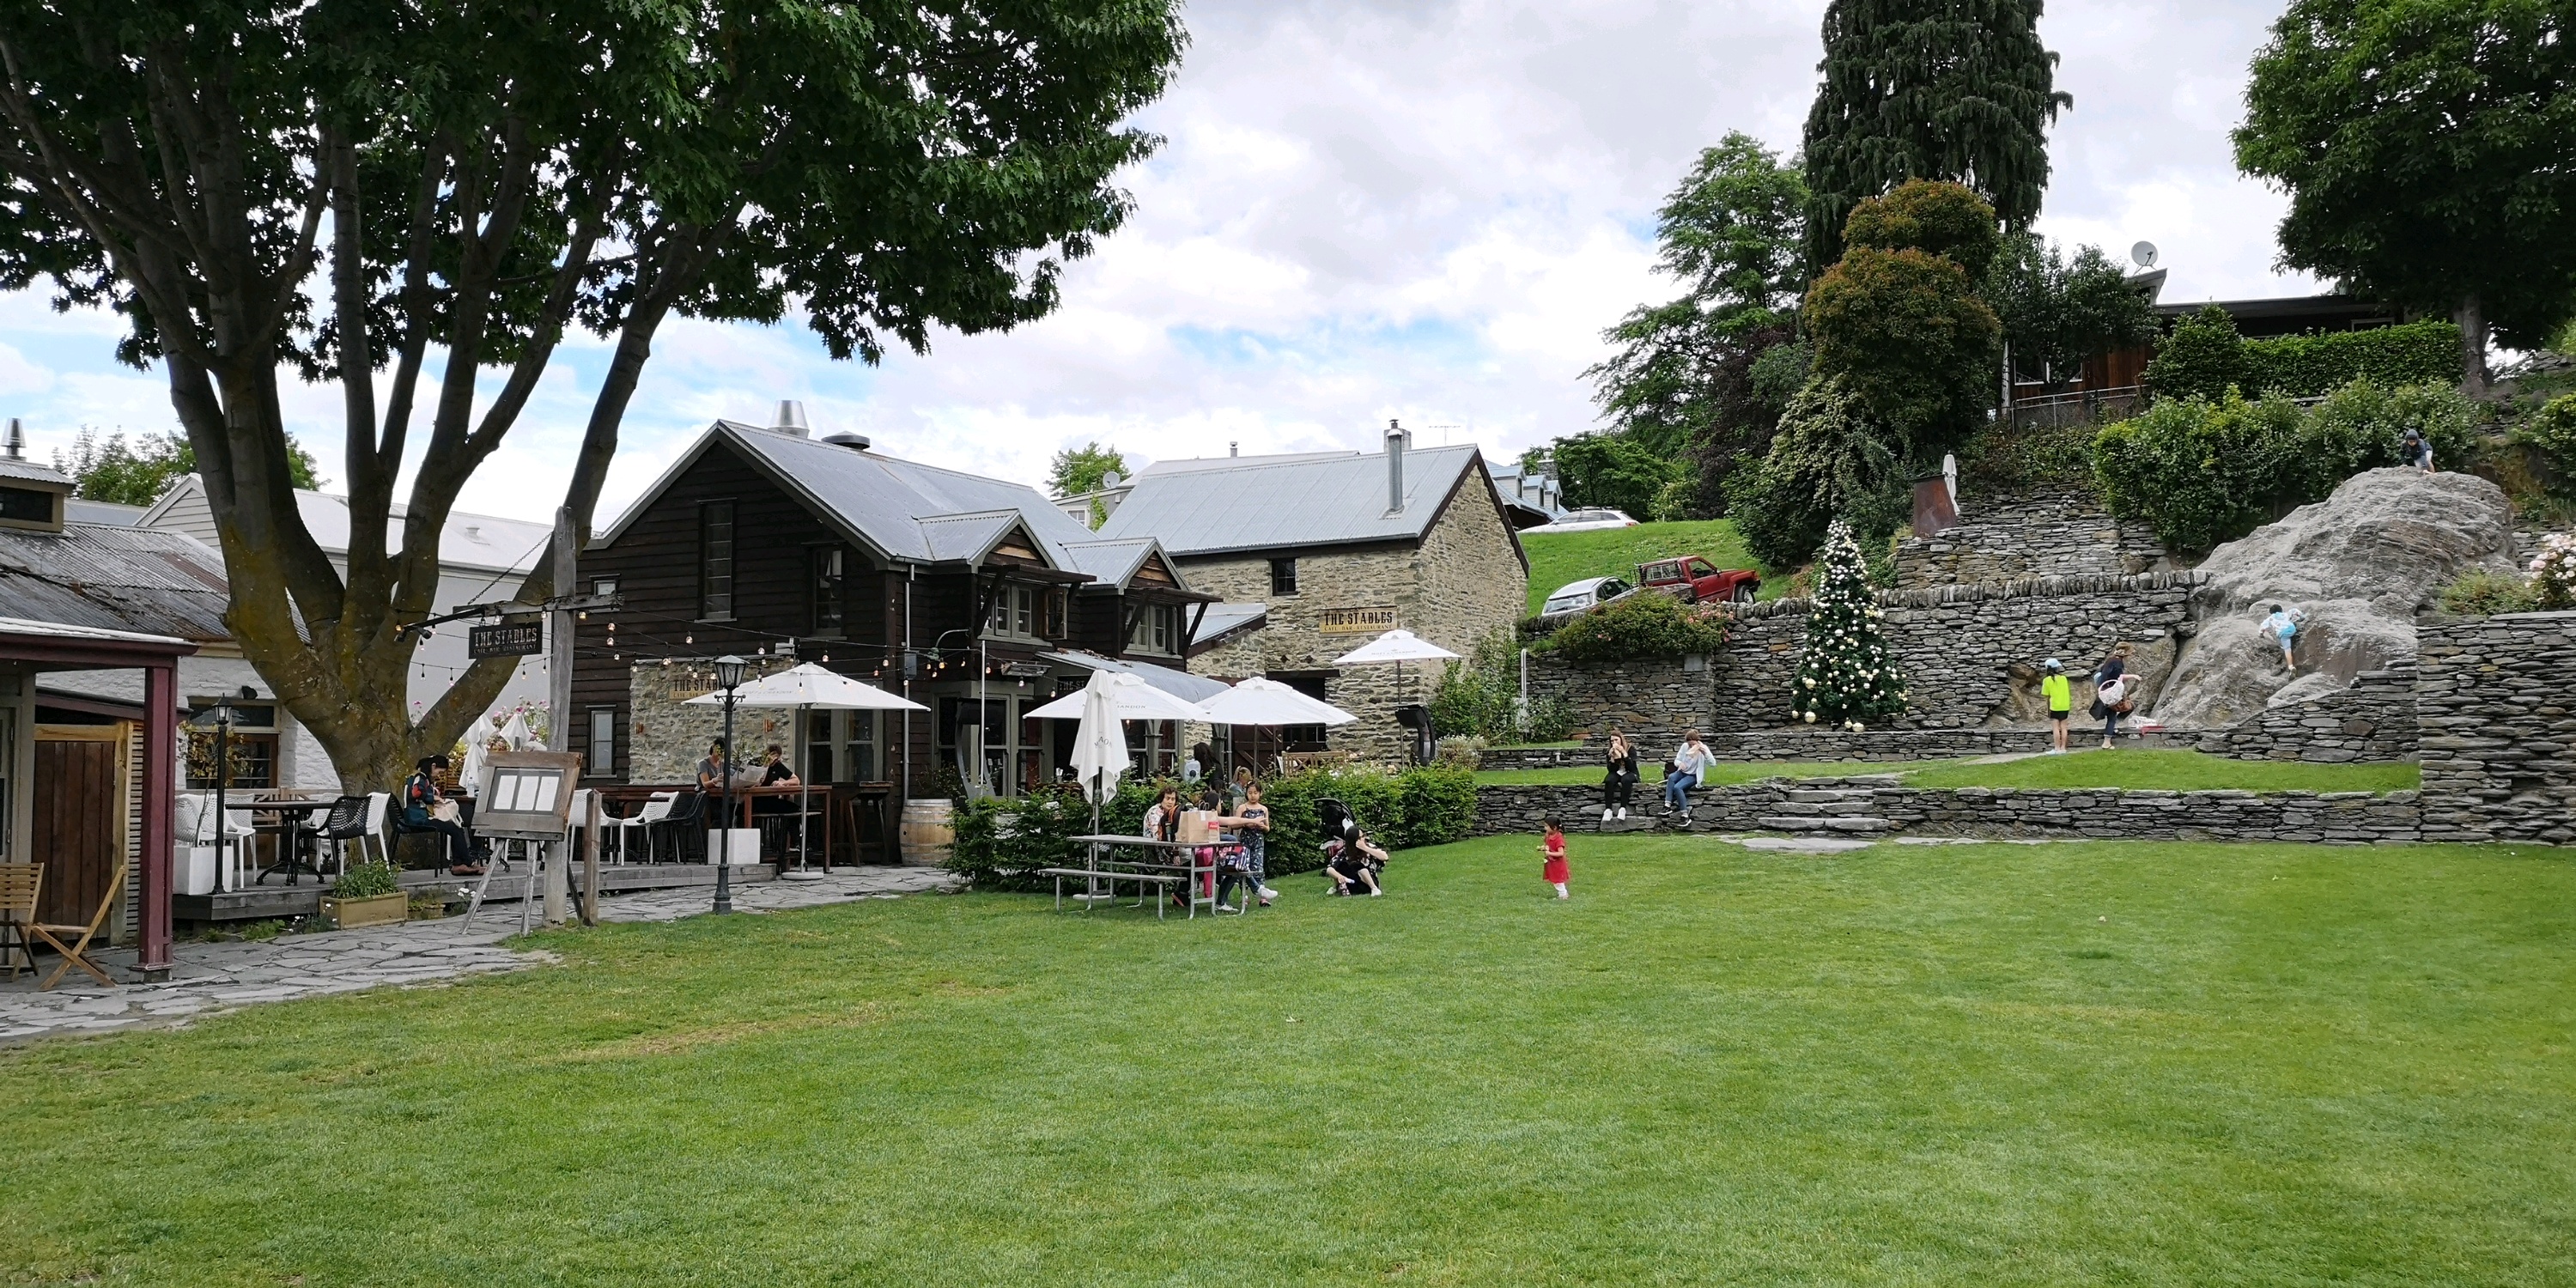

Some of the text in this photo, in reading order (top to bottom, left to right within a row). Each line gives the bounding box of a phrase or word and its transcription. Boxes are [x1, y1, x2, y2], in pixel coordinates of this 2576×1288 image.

[1325, 611, 1393, 626] THE STABLES
[474, 628, 538, 647] THE STABLES
[674, 678, 721, 691] THE STAB
